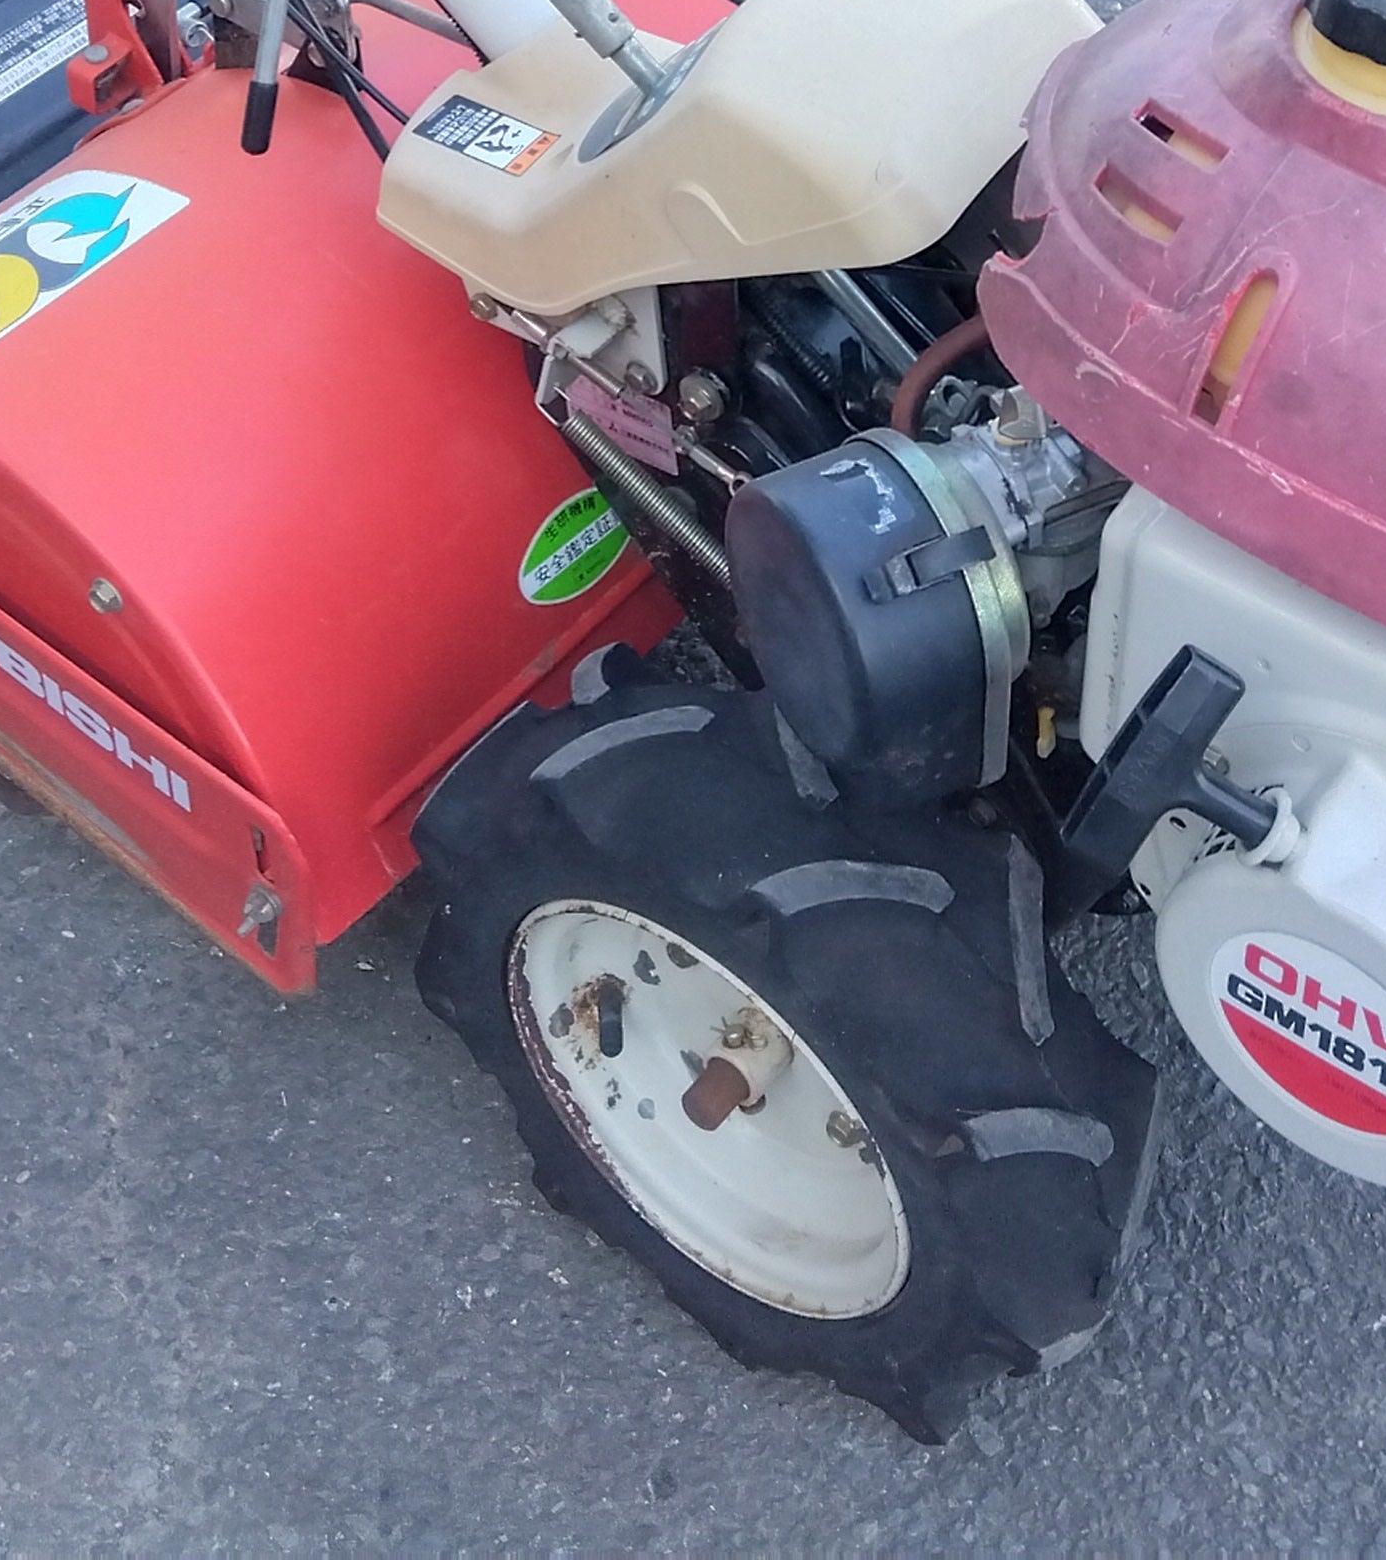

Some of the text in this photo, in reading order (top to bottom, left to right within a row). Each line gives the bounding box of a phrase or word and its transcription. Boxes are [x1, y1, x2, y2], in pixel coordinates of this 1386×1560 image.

[534, 510, 620, 586] 安全鑑定証
